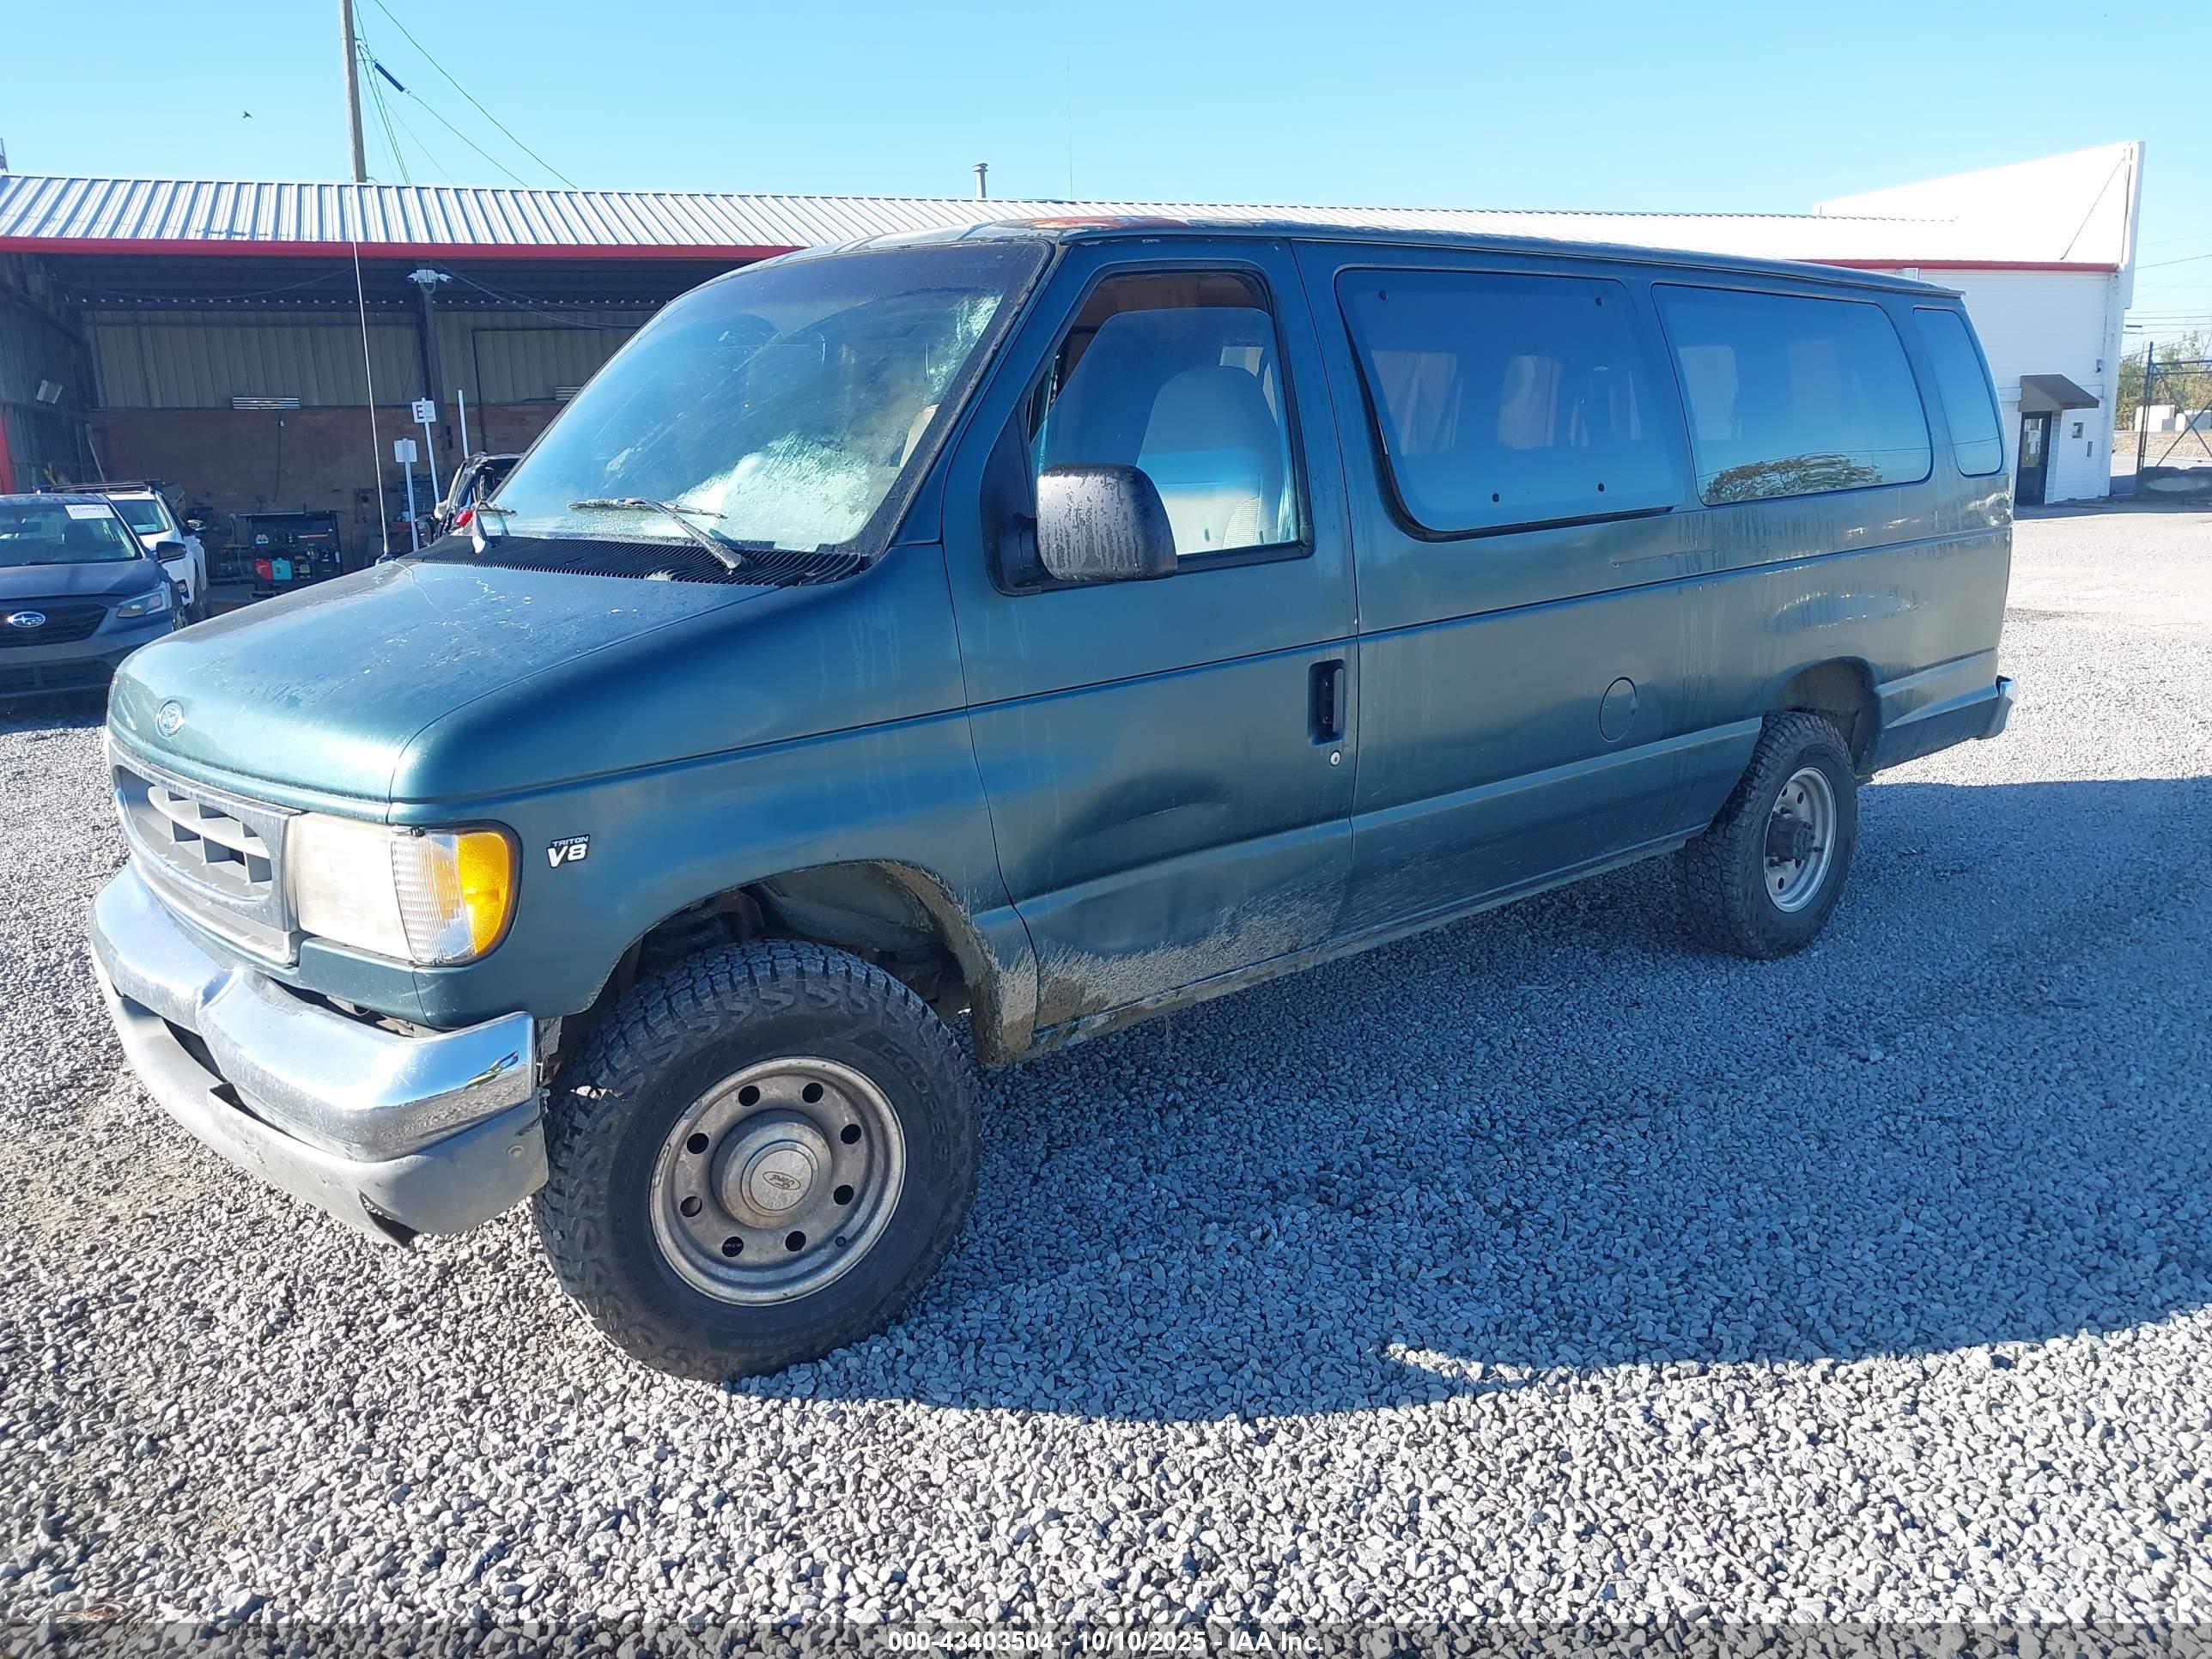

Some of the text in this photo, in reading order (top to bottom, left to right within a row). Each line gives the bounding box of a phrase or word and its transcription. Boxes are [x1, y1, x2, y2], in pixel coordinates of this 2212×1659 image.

[551, 836, 589, 848] TRITON
[547, 843, 587, 867] V8
[878, 1042, 949, 1162] COOPER
